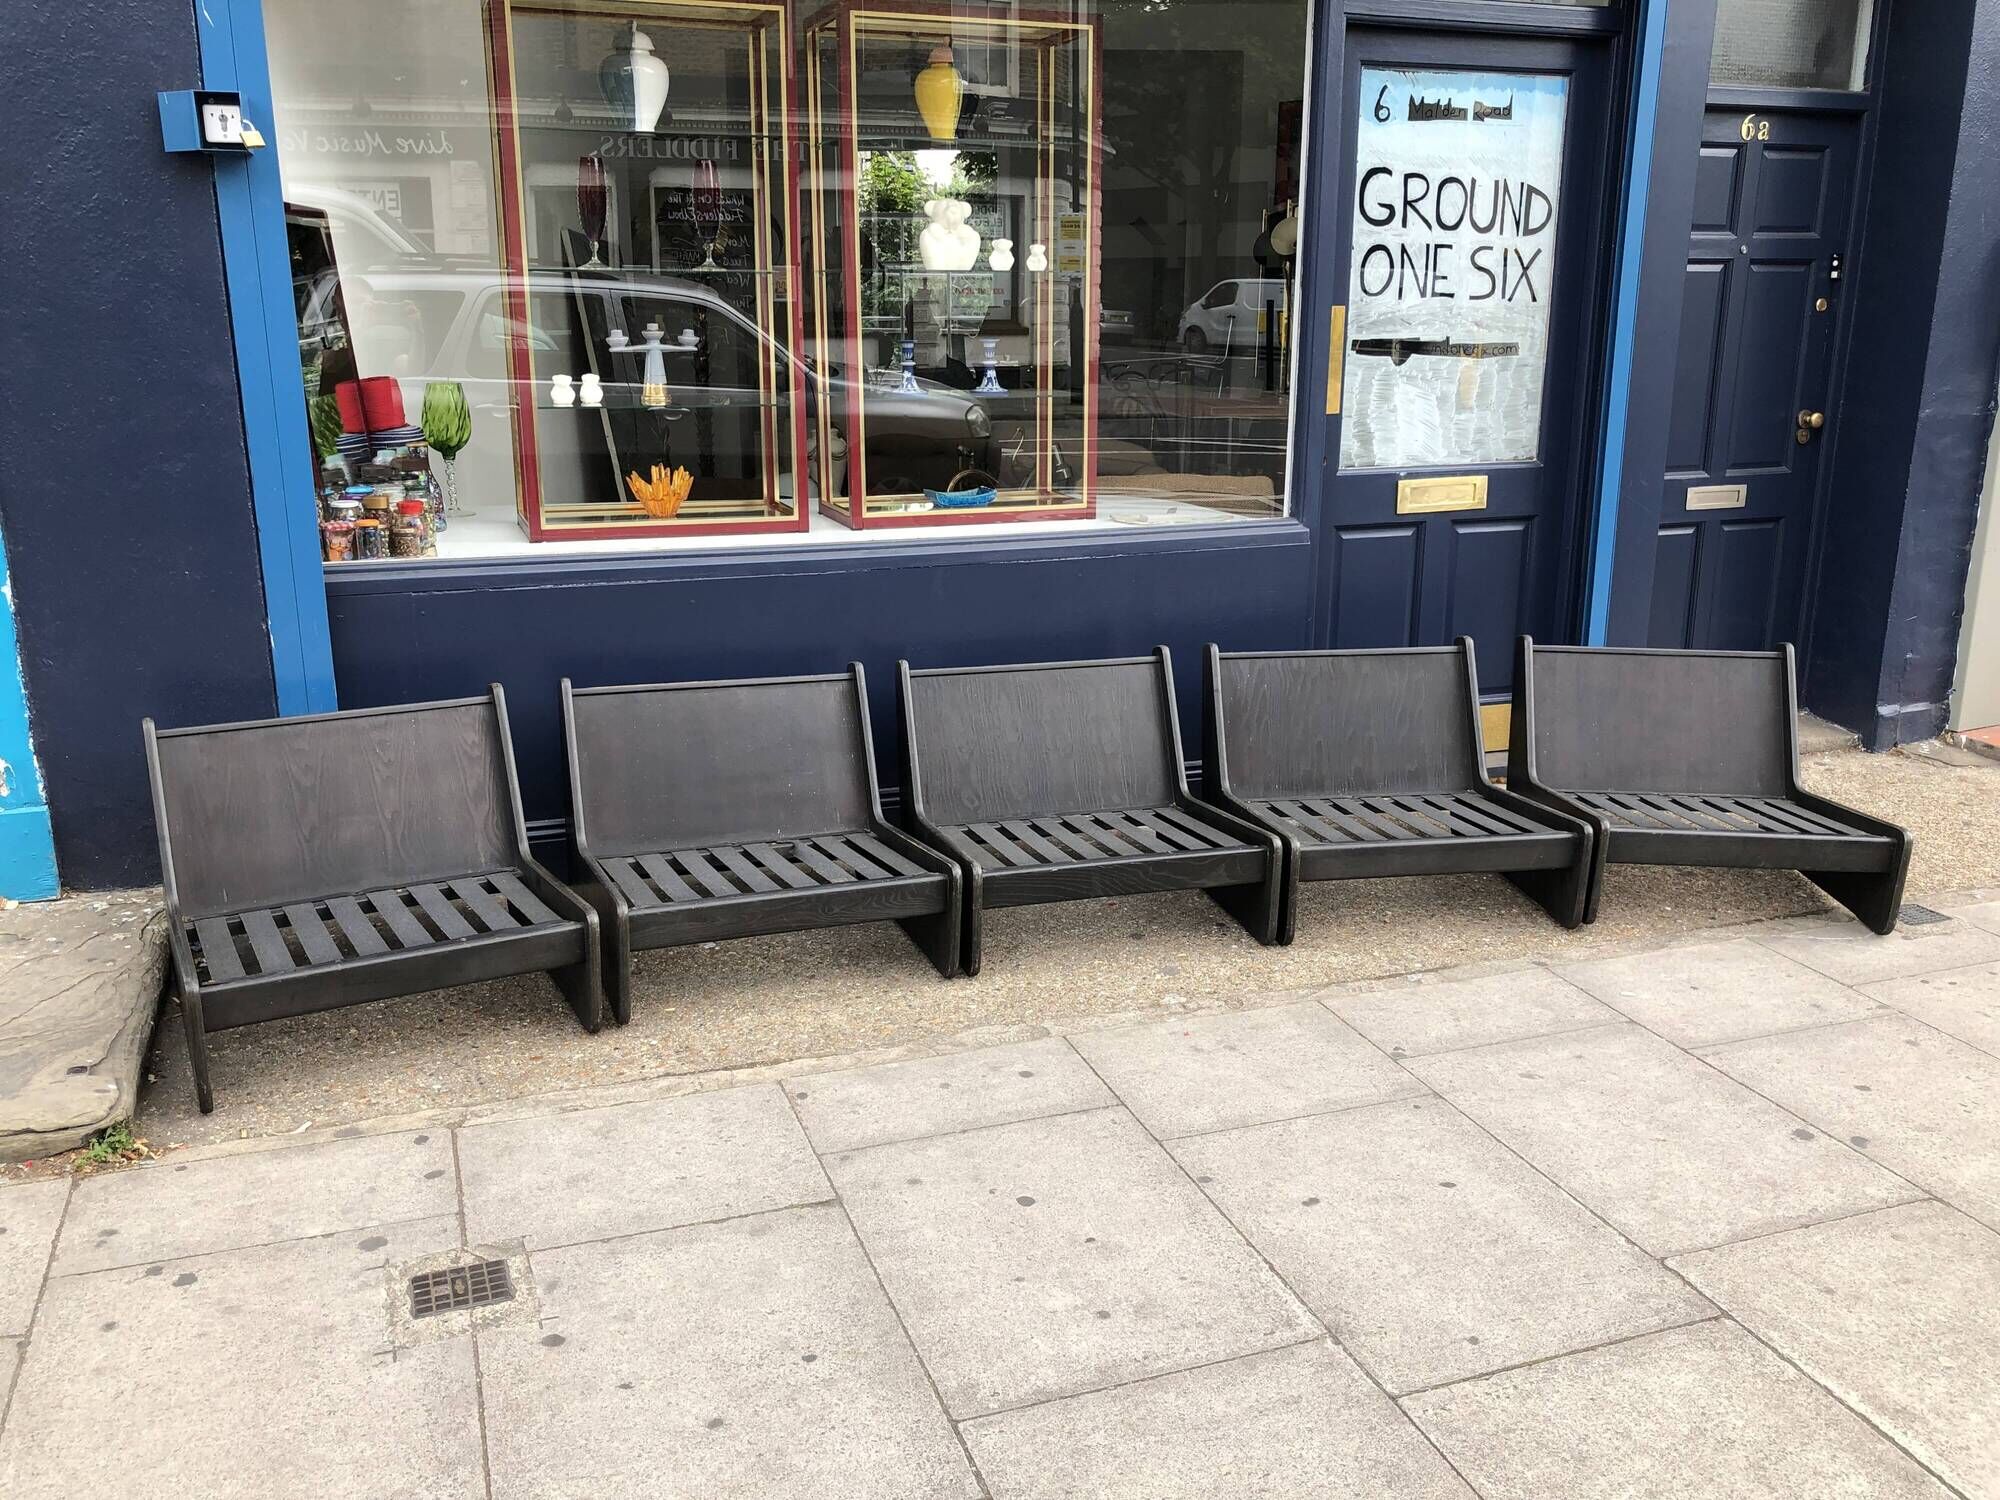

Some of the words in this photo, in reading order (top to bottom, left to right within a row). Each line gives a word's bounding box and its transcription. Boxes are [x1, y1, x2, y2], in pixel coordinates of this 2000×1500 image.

[1373, 84, 1391, 122] 6
[1408, 94, 1467, 121] Malden
[1473, 93, 1513, 122] Road
[1739, 113, 1771, 142] 6a
[1358, 165, 1553, 237] GROUND
[1359, 243, 1455, 303] ONE
[1468, 246, 1543, 303] SIX
